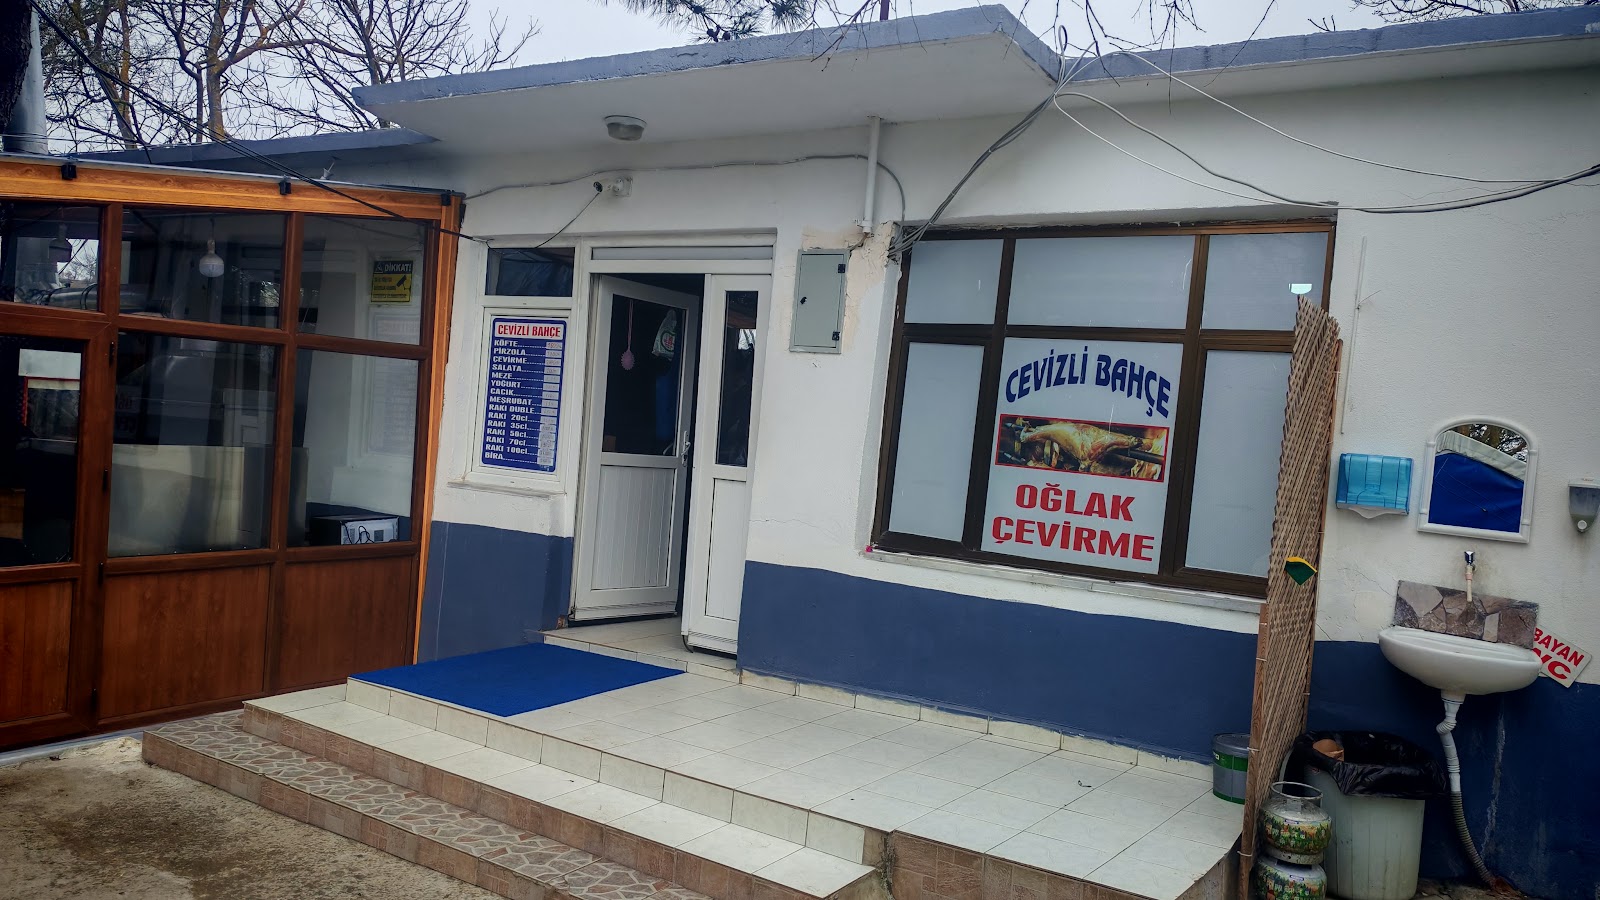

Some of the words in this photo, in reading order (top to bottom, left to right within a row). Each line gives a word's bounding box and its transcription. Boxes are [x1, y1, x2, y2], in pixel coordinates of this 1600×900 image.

[498, 324, 530, 336] CEVİZLİ
[532, 326, 561, 338] BAHÇE
[493, 347, 526, 356] PİRZOLA
[492, 364, 522, 372] SALATA
[1005, 345, 1089, 403] CEVİZLİ
[1095, 354, 1171, 419] BAHÇE
[489, 396, 533, 405] MEŞRUBAT
[509, 405, 535, 414] DUBLE
[488, 412, 506, 420] RAKI
[487, 420, 506, 428] RAKI
[487, 428, 505, 436] RAKI
[486, 436, 504, 444] RAKI
[485, 444, 504, 452] RAKI
[485, 452, 503, 460] BİRA
[1015, 482, 1136, 522] OĞLAK
[991, 516, 1155, 562] ÇEVİRME
[1533, 627, 1585, 668] BAYAN
